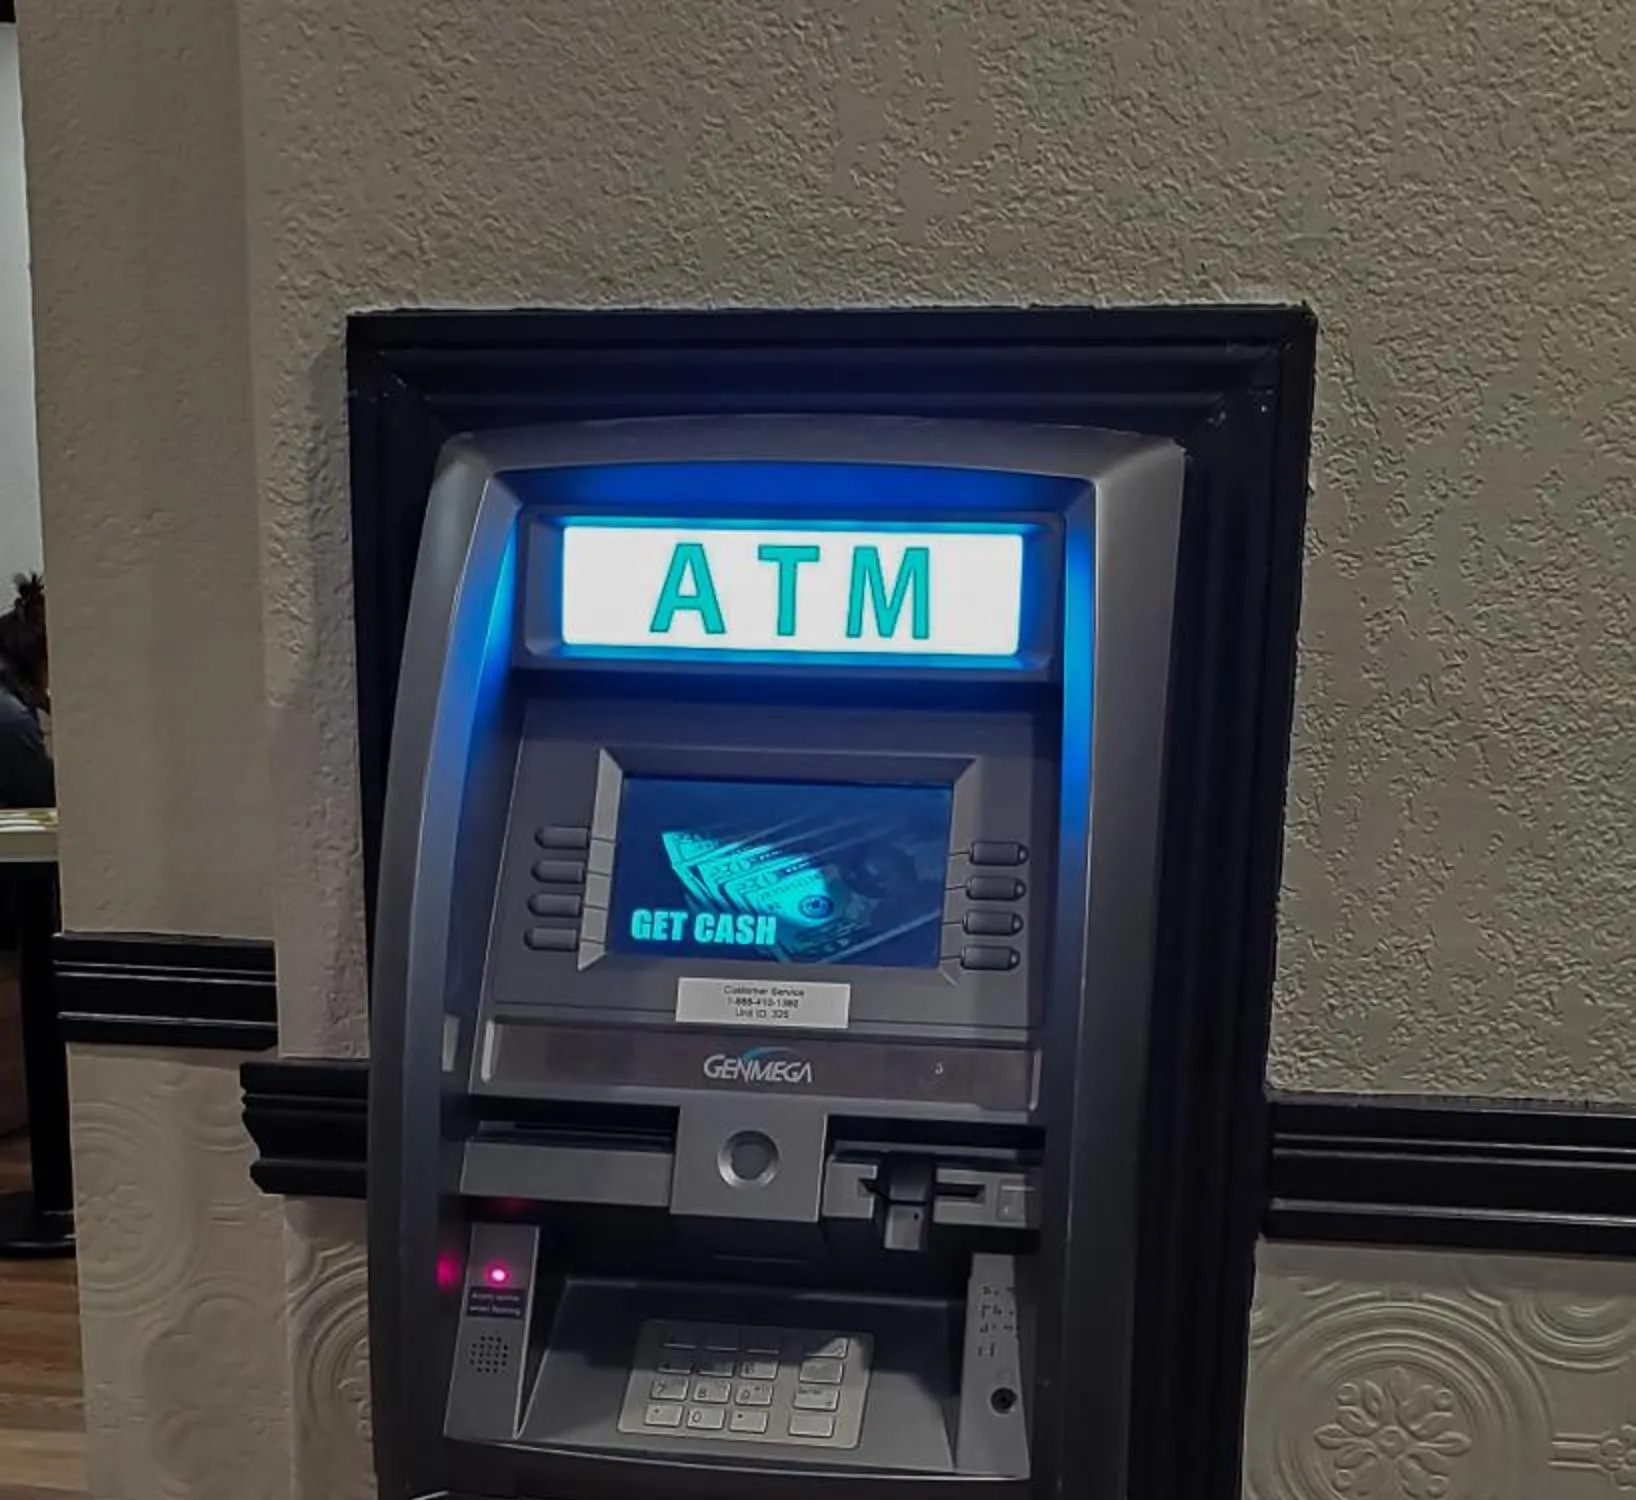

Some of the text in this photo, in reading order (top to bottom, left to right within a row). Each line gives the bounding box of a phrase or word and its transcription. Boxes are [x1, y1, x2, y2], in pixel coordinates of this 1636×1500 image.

[649, 543, 930, 640] ATM
[631, 908, 777, 945] GET CASH
[723, 985, 805, 998] Customer Service
[703, 1054, 813, 1083] GENMEGA
